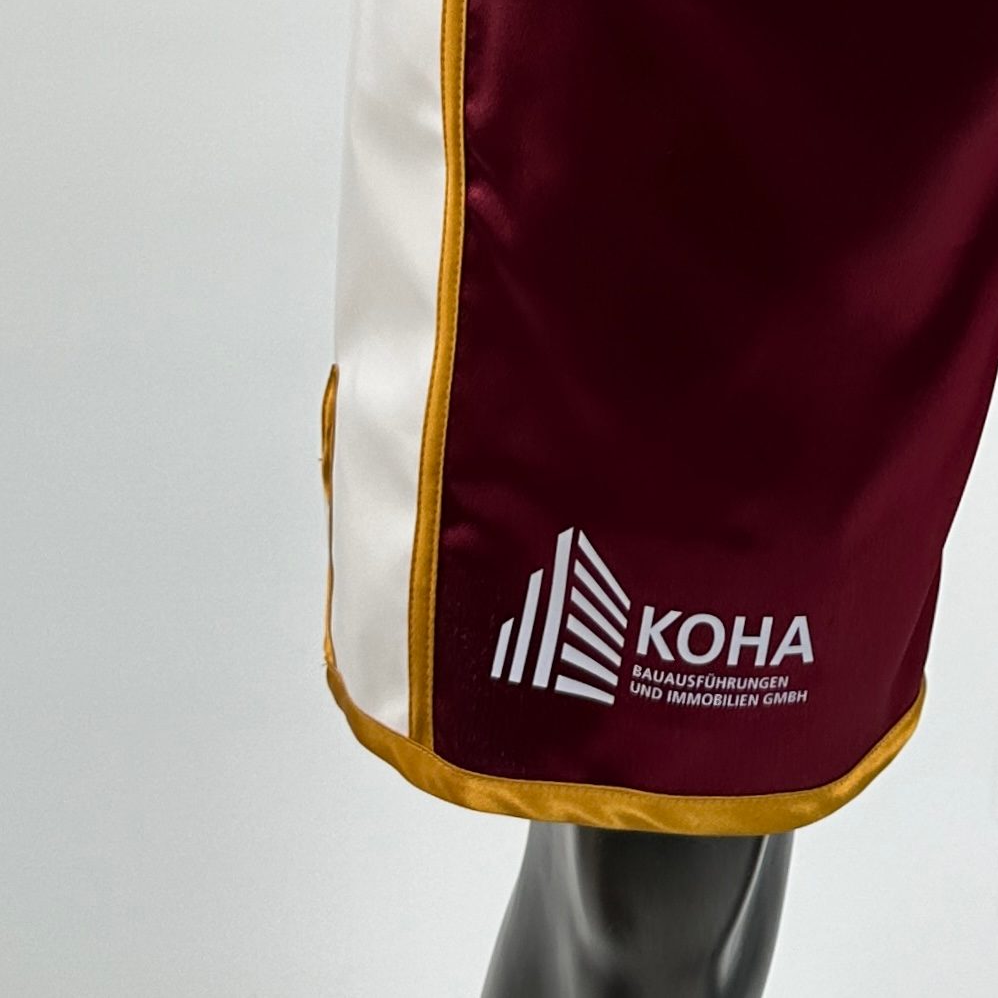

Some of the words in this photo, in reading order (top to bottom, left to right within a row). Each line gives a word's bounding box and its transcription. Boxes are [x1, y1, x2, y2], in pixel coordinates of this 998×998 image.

[636, 605, 814, 667] KOHA
[632, 664, 789, 690] BAUAUSFÜHRUNGEN
[629, 680, 663, 700] UND
[666, 689, 759, 707] IMMOBILIEN
[762, 690, 808, 705] GMBH
